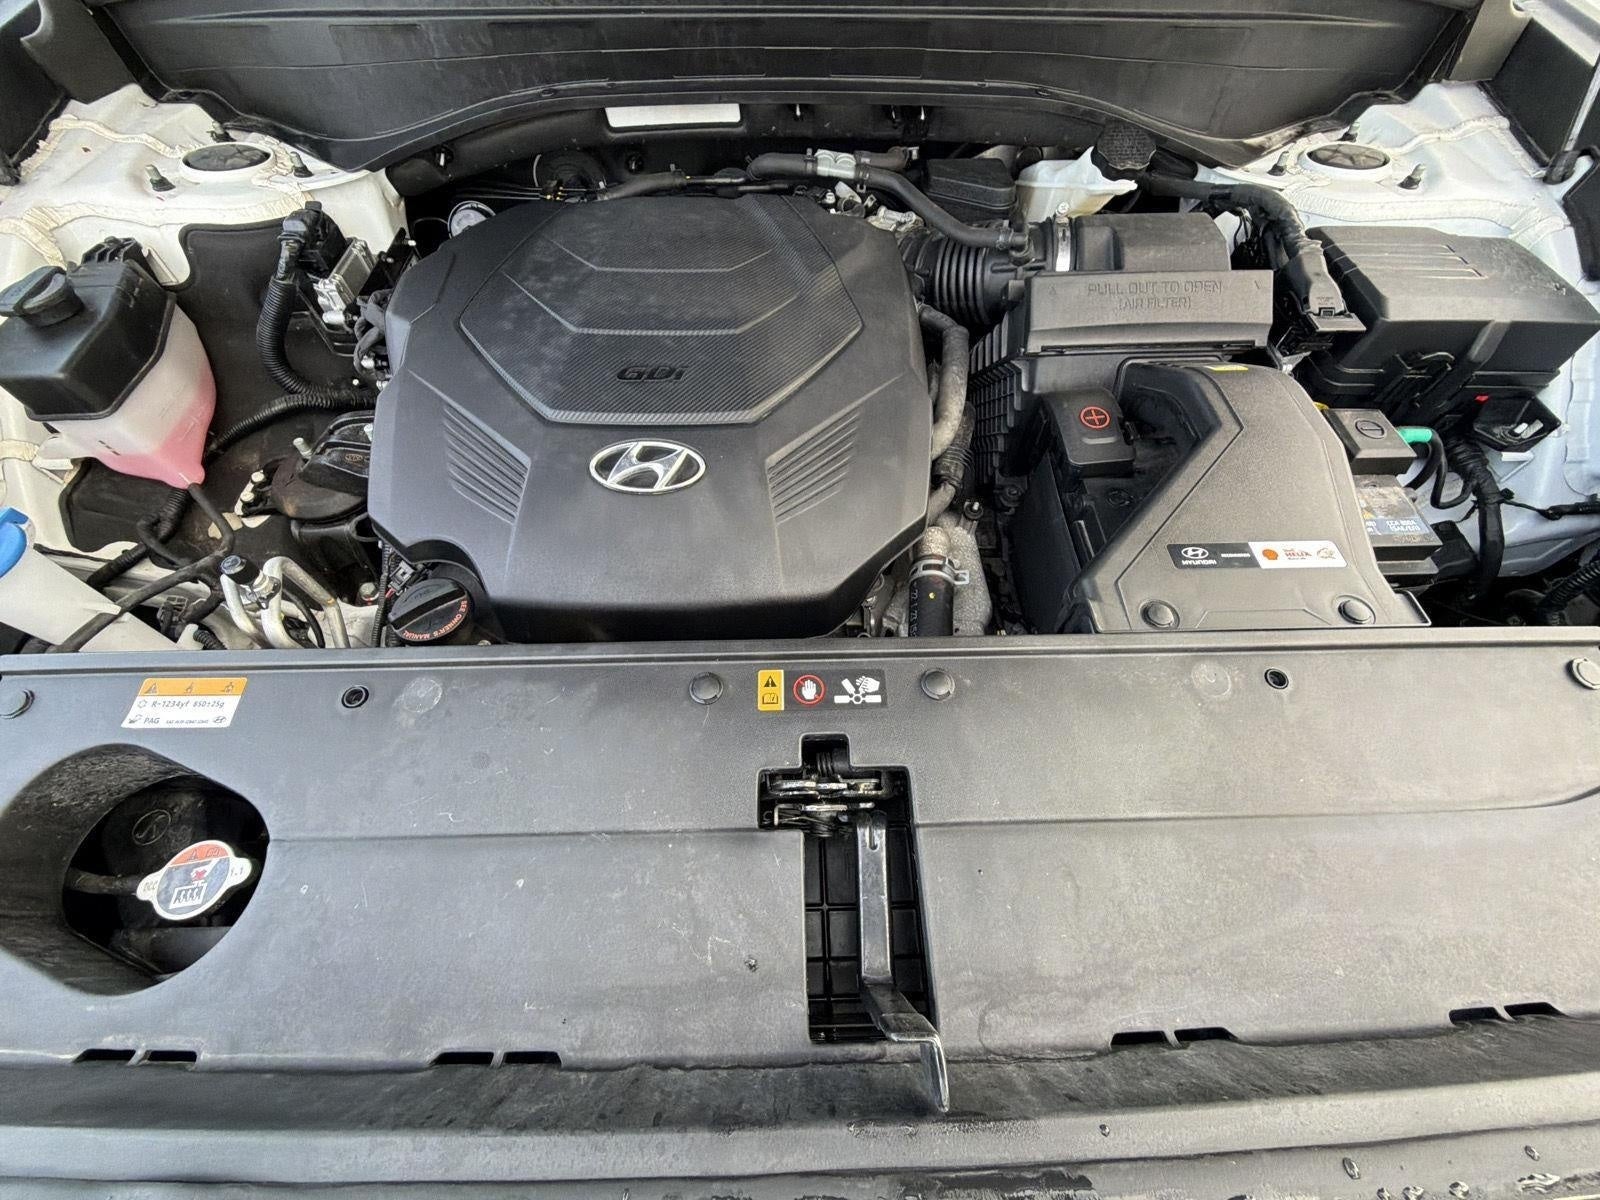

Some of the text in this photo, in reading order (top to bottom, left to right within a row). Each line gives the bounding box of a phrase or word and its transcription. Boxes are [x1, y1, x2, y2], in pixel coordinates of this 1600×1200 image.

[1087, 280, 1223, 296] PULL OUT TO OPEN
[402, 629, 431, 640] MANUAL
[151, 700, 190, 710] R-1234yf
[143, 717, 161, 725] PAG
